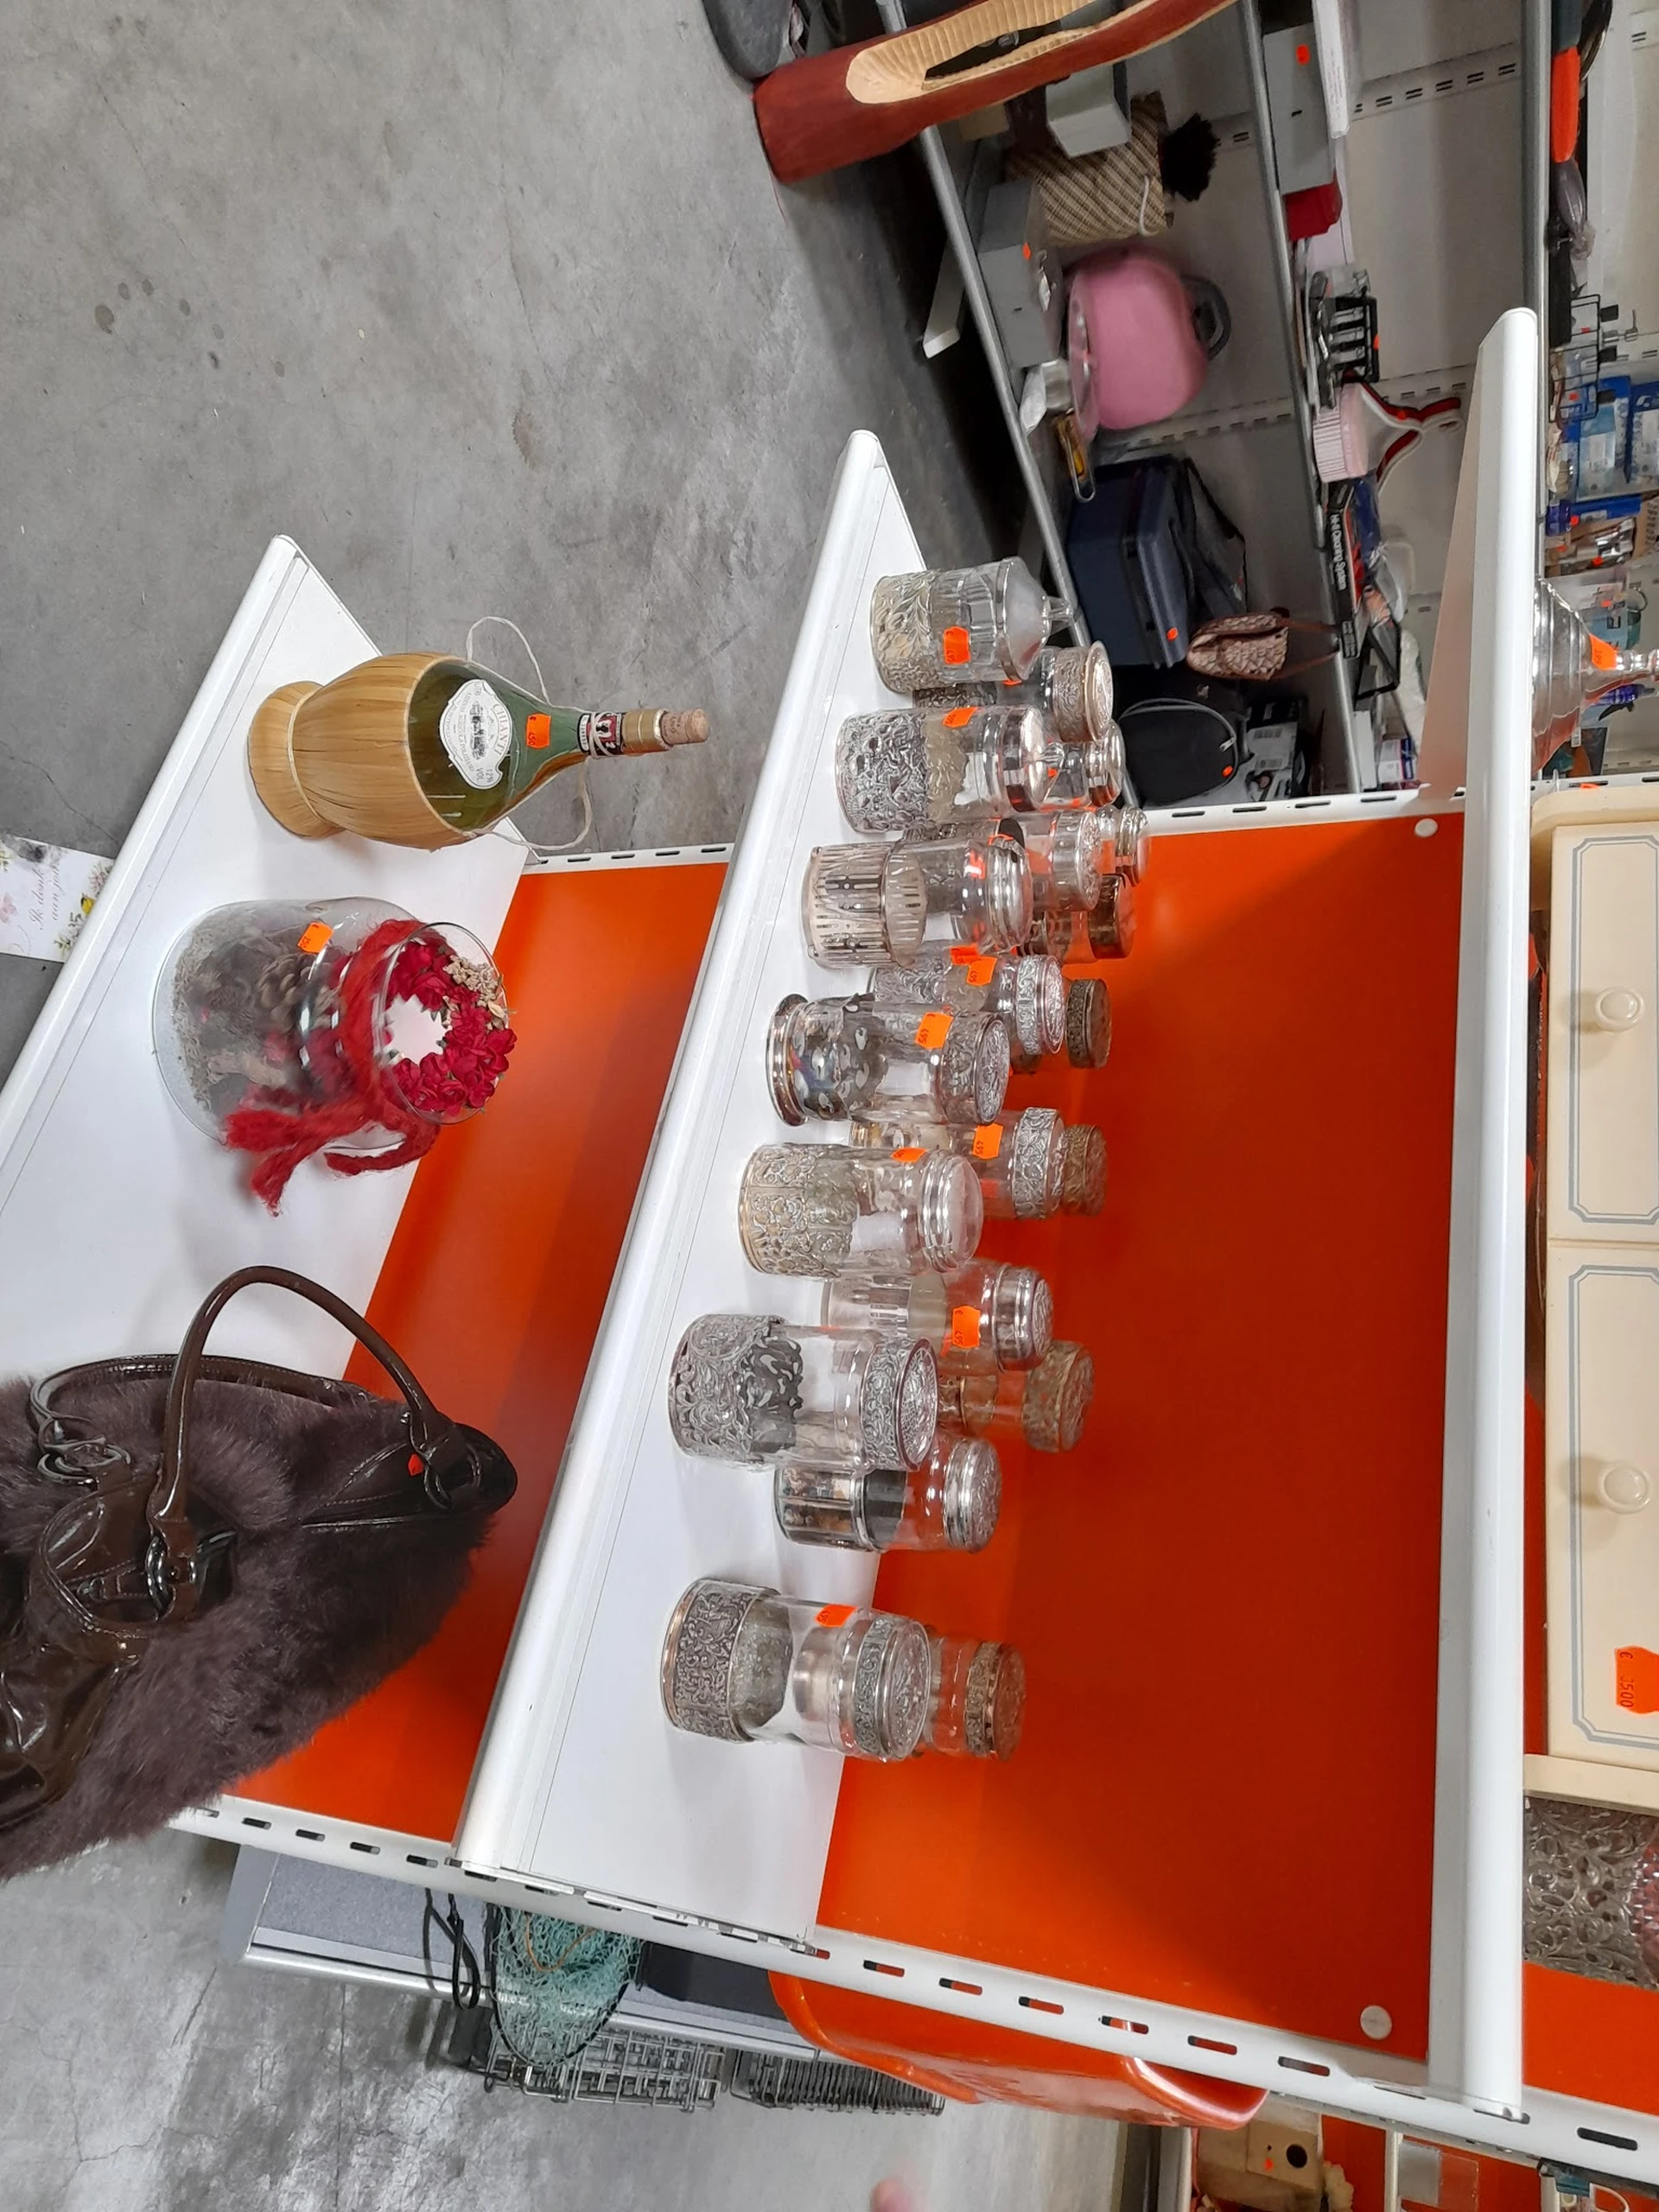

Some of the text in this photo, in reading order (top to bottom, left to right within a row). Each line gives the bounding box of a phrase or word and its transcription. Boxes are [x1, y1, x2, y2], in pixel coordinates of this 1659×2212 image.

[1332, 531, 1343, 562] Cleaning
[1336, 562, 1346, 590] System
[492, 703, 508, 756] CHIANTI
[486, 768, 494, 783] 12%
[29, 868, 44, 930] Ik denk
[51, 893, 60, 921] aan
[918, 1028, 929, 1044] 495
[975, 1140, 983, 1155] 495
[954, 1330, 963, 1345] 495
